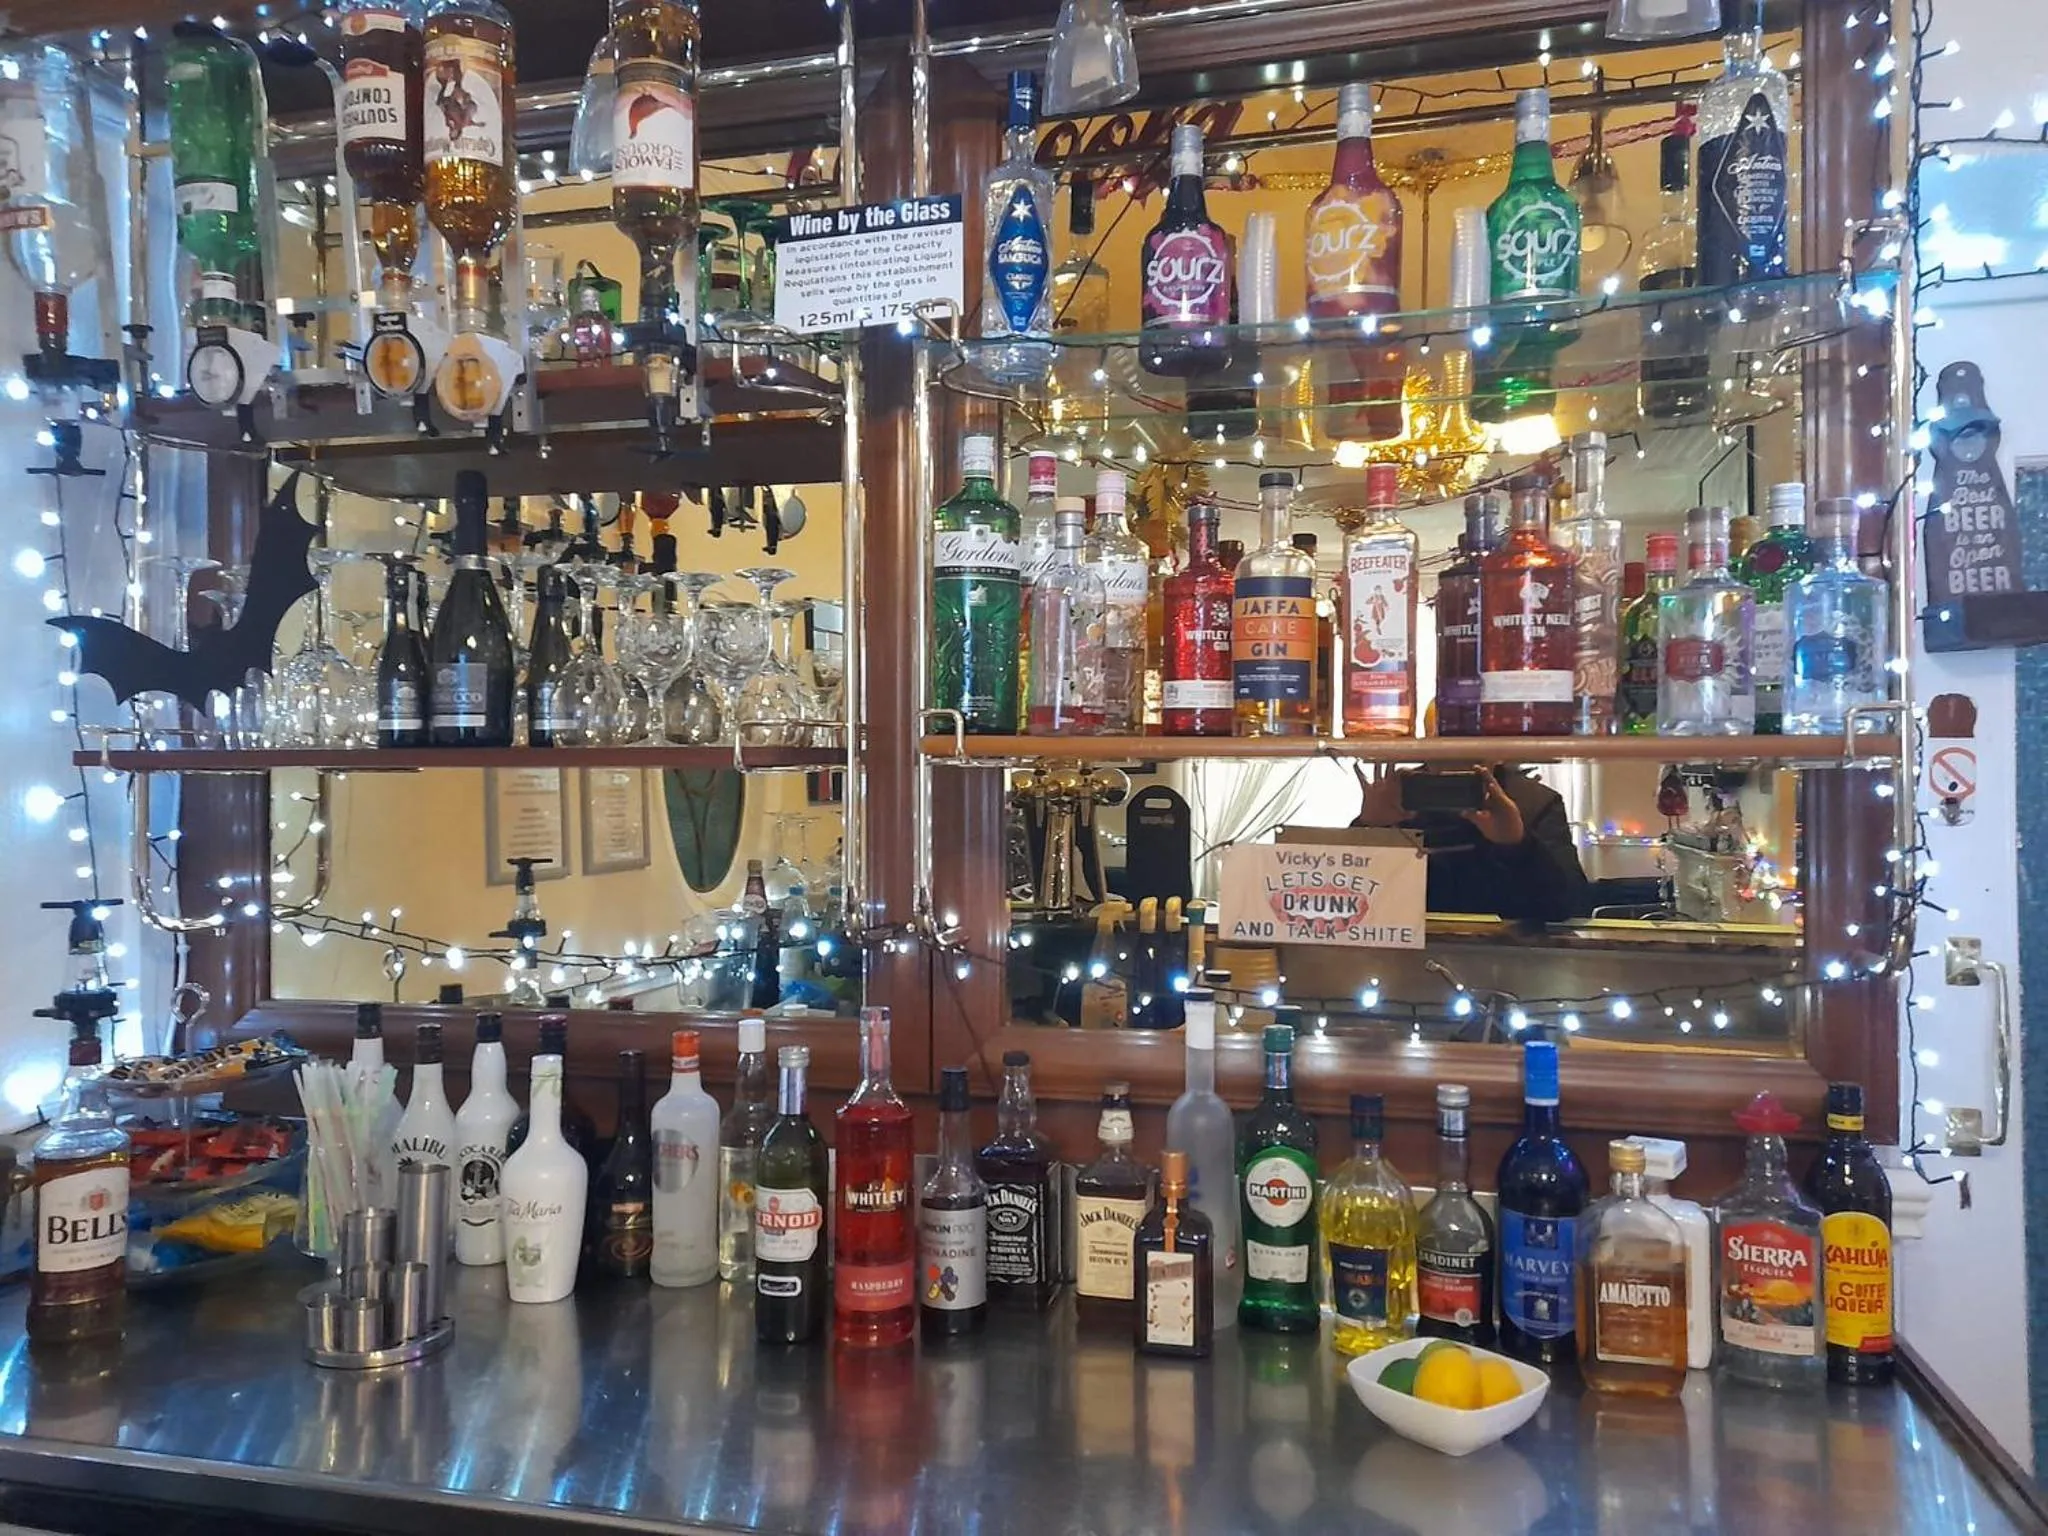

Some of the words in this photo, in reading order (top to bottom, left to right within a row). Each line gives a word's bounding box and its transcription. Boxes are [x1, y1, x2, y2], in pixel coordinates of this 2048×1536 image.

[790, 215, 832, 237] Wine
[838, 210, 860, 233] by
[866, 206, 895, 228] the
[901, 201, 951, 223] Glass
[800, 239, 861, 252] accordance
[865, 234, 888, 244] with
[891, 233, 908, 241] the
[912, 227, 953, 238] revised
[795, 251, 851, 264] legislation
[854, 248, 869, 257] for
[873, 246, 890, 254] the
[894, 240, 943, 252] Capacity
[784, 275, 847, 288] Regulations
[851, 271, 872, 279] this
[876, 261, 953, 277] establishment
[785, 265, 836, 276] Measures
[800, 288, 824, 298] sells
[829, 285, 852, 294] wine
[856, 283, 869, 291] by
[873, 281, 890, 289] the
[894, 277, 922, 288] glass
[926, 275, 937, 283] in
[892, 289, 902, 298] of
[799, 308, 854, 328] 125ml
[1956, 470, 1991, 485] The
[1951, 486, 1997, 506] Best
[1944, 504, 2006, 532] BEER
[1956, 534, 1970, 546] is
[1973, 533, 1996, 545] an
[1350, 555, 1407, 574] BEEFEATER
[1950, 544, 2005, 569] Open
[1948, 566, 2012, 594] BEER
[1242, 601, 1300, 616] JAFFA
[1245, 621, 1297, 636] CAKE
[1493, 614, 1543, 627] WHITLEY
[1184, 630, 1229, 640] WHITLEY
[1251, 642, 1288, 657] GIN
[1276, 851, 1336, 869] Vicky's
[1341, 852, 1372, 868] Bar
[1266, 872, 1323, 891] LETS
[1332, 872, 1380, 896] GET
[1283, 893, 1359, 913] DRUNK
[1234, 921, 1273, 936] AND
[1288, 924, 1336, 939] TALK
[1349, 926, 1412, 943] SHITE
[847, 1189, 905, 1206] WHITLEY
[1251, 1183, 1307, 1199] MARTINI
[1080, 1210, 1102, 1228] JACK
[1728, 1235, 1809, 1268] SIERRA
[1742, 1263, 1794, 1278] TEQUILA
[851, 1278, 904, 1291] RASPBERRY
[1600, 1282, 1671, 1307] AMARETTO
